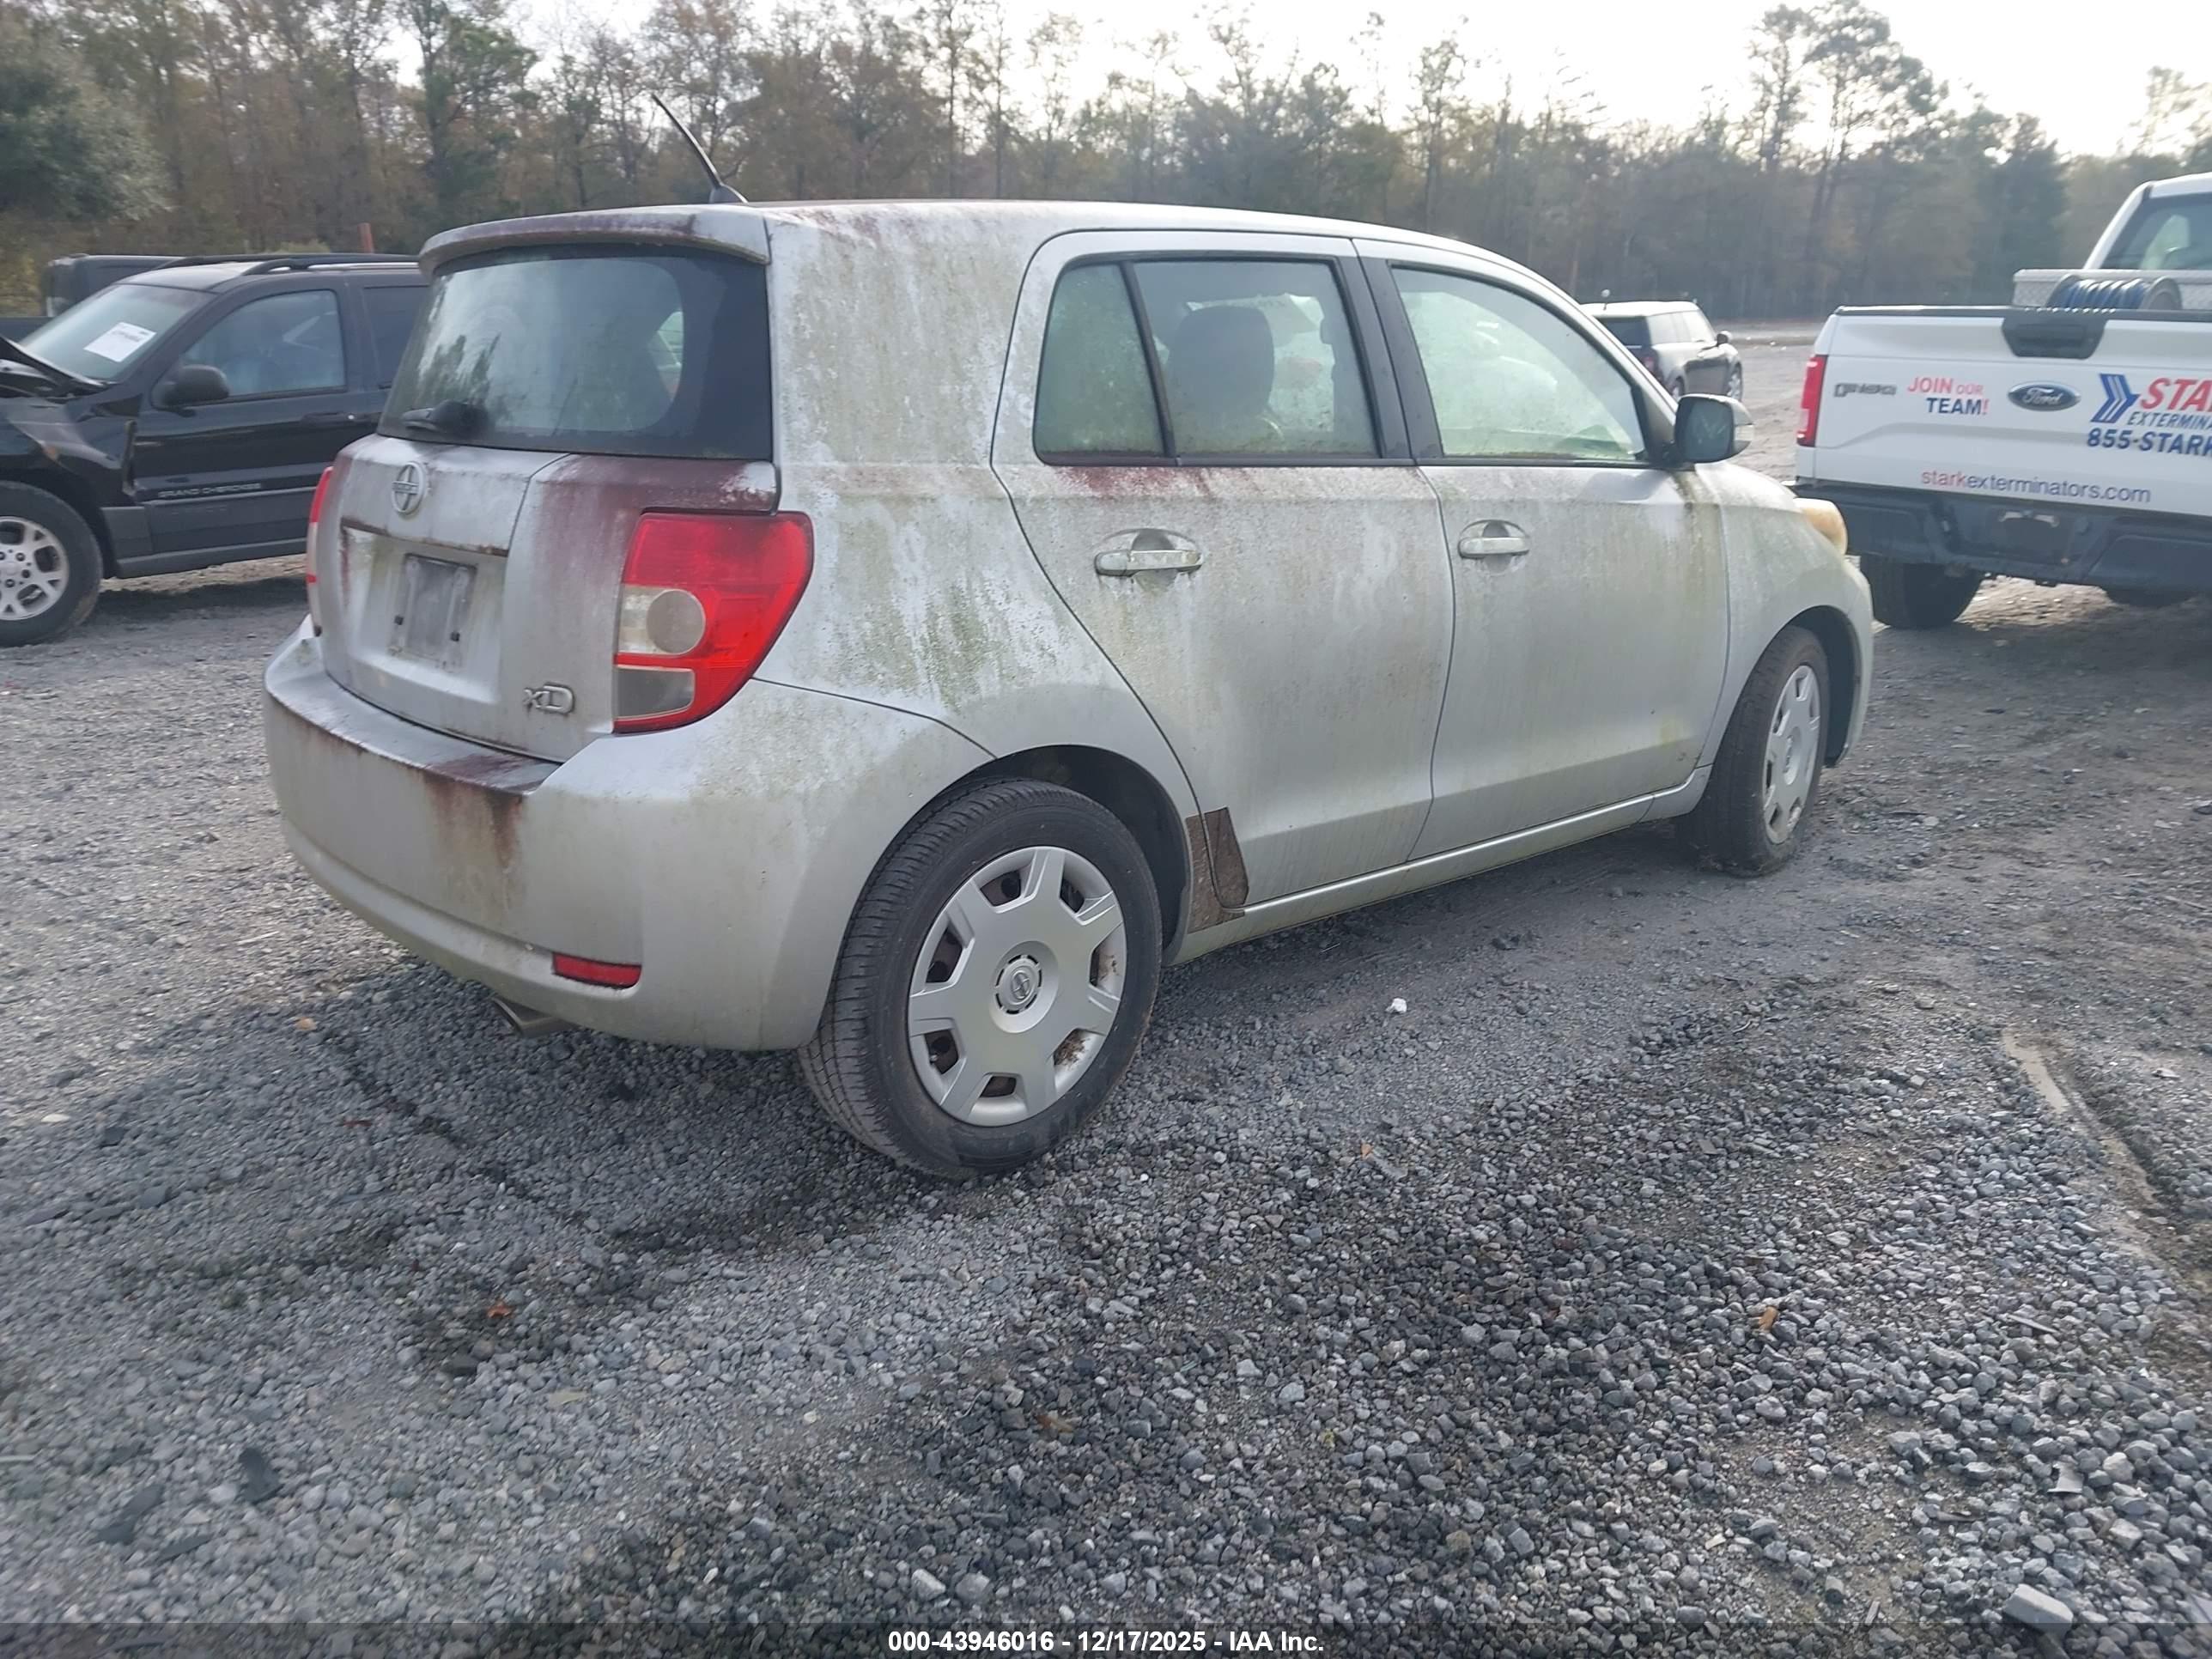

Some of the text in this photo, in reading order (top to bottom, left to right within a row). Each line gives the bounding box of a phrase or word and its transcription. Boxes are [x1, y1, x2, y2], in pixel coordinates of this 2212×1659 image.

[1907, 376, 1954, 394] JOIN
[1955, 383, 1984, 396] OUR
[2141, 377, 2212, 413] STA
[1926, 397, 1990, 416] TEAM!
[1921, 470, 2152, 503] starkexterminators.com
